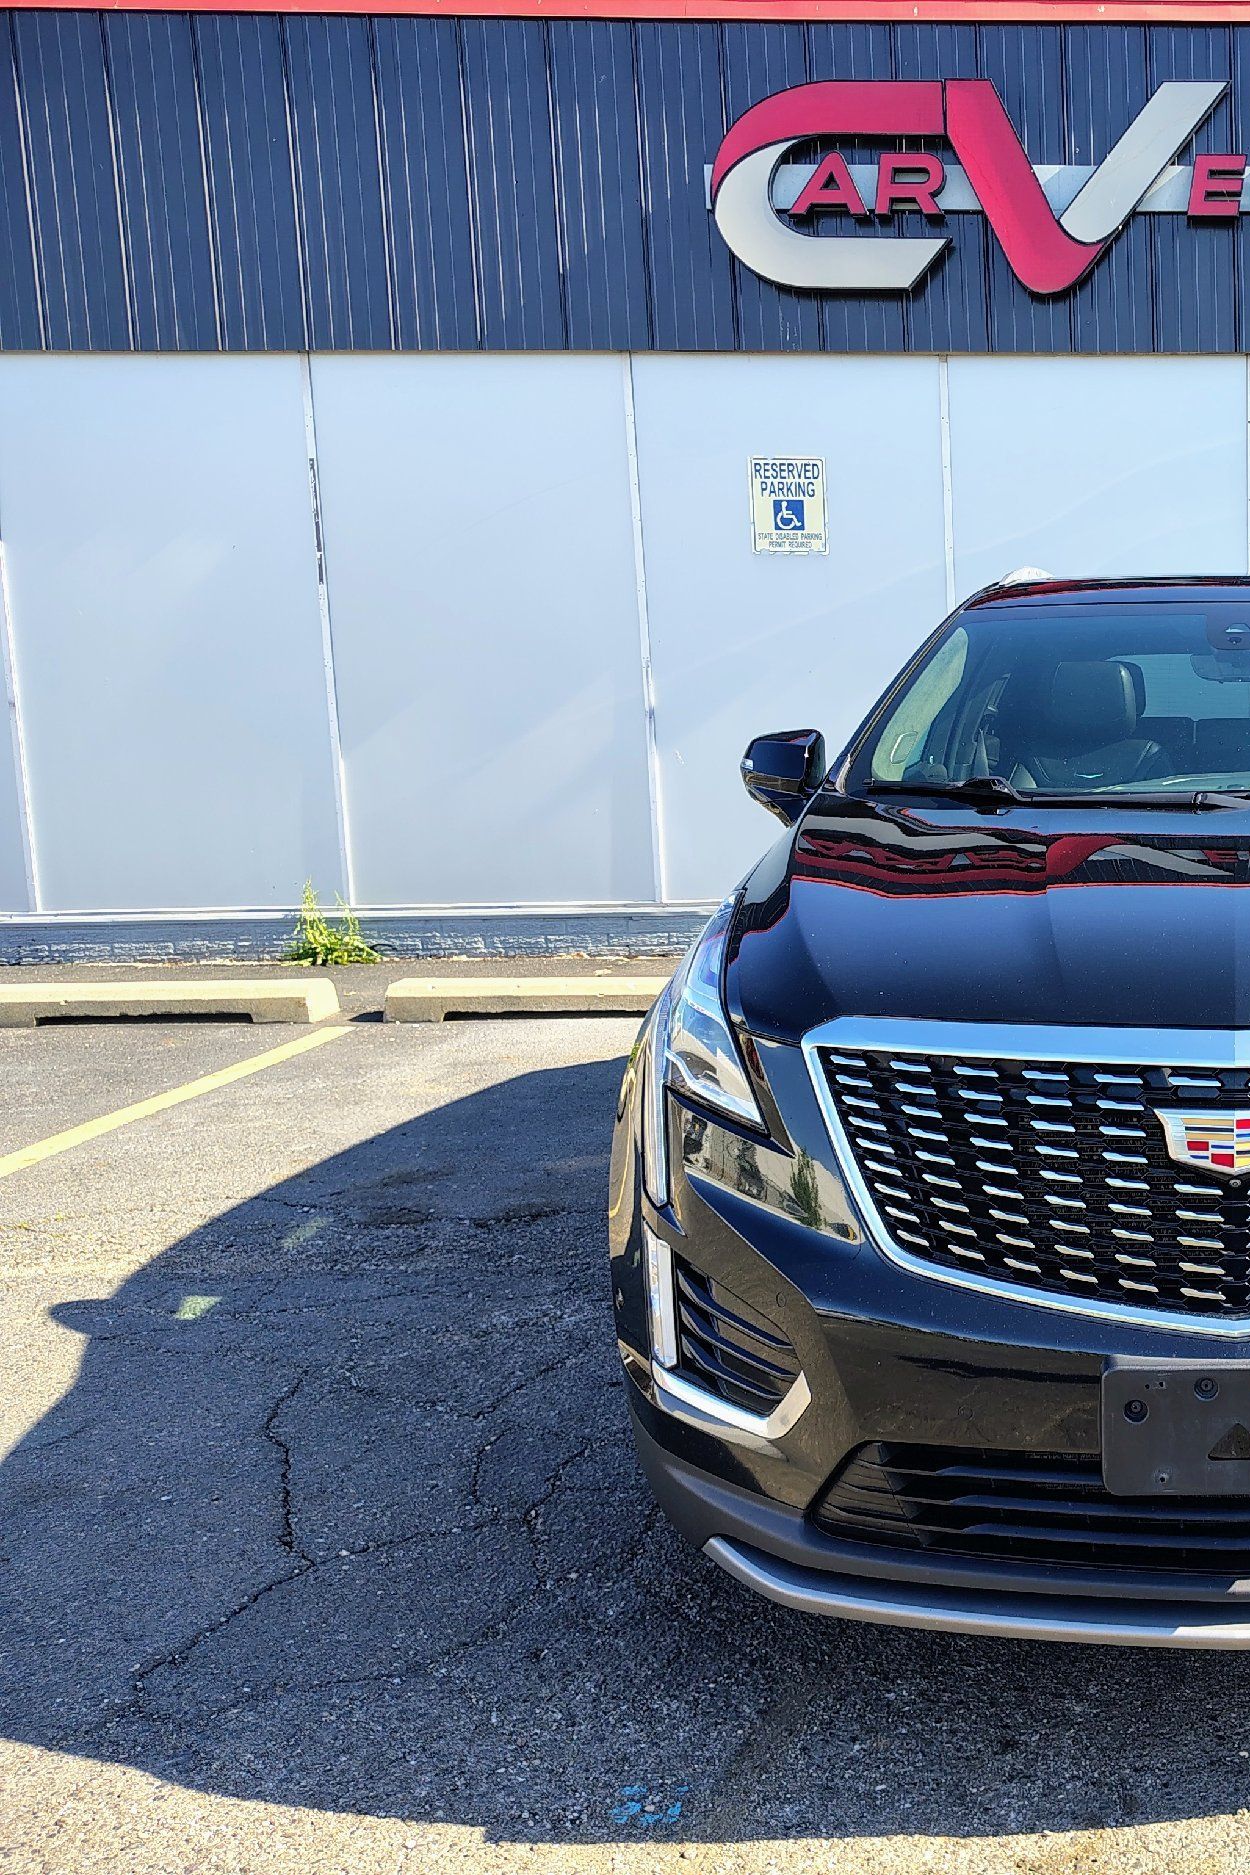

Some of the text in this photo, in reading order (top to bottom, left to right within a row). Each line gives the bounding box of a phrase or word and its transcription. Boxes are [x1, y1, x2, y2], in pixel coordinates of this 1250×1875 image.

[753, 462, 820, 480] RESERVED
[760, 481, 815, 498] PARKING
[758, 532, 774, 541] STATE
[800, 532, 823, 541] PARKING
[768, 541, 787, 549] PERMIT
